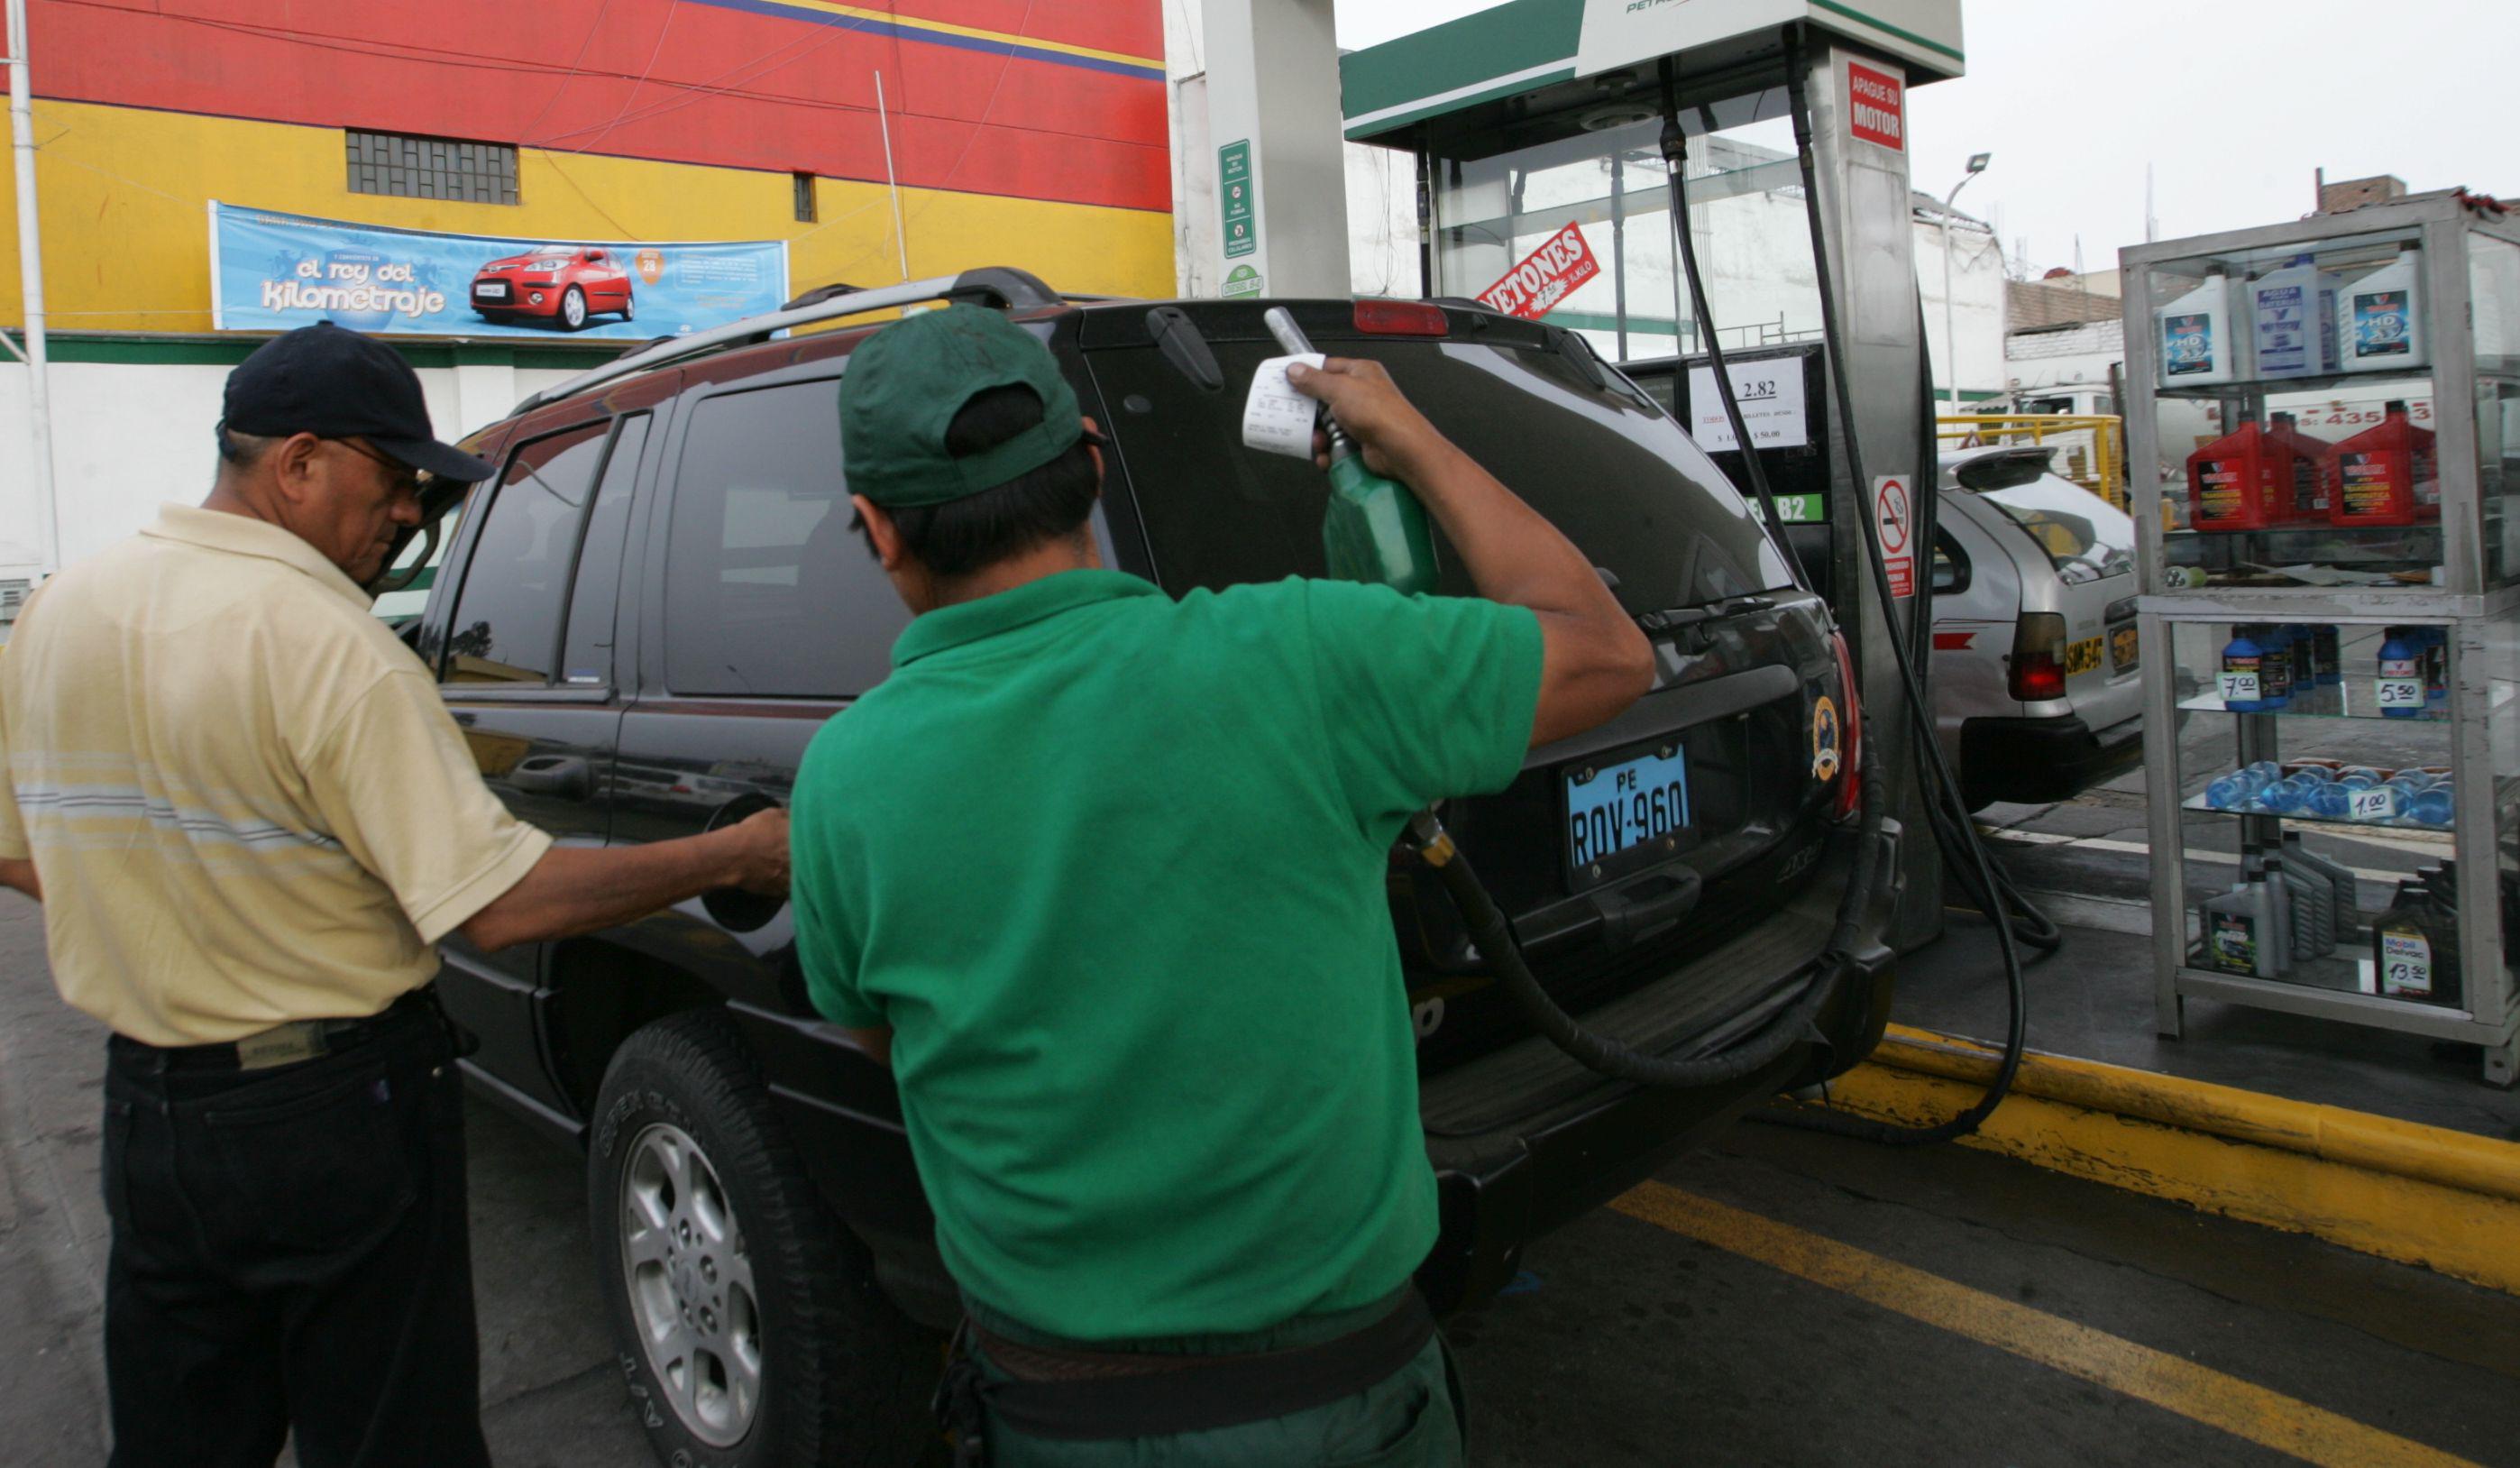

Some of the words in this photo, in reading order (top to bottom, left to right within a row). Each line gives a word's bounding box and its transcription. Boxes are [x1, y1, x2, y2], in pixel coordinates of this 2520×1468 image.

[1853, 76, 1886, 101] APAGUE
[1887, 88, 1898, 106] SU
[1854, 101, 1900, 138] MOTOR
[297, 259, 323, 280] el
[328, 261, 370, 285] rey
[376, 262, 416, 283] del
[1744, 381, 1776, 398] 2.82
[1777, 497, 1806, 520] B2
[2223, 677, 2256, 697] 7.00
[1617, 768, 1636, 793] PE
[2355, 794, 2386, 815] 1.00
[2385, 938, 2416, 949] Mobil
[2386, 946, 2424, 959] Delvac
[2388, 963, 2427, 981] 13.50
